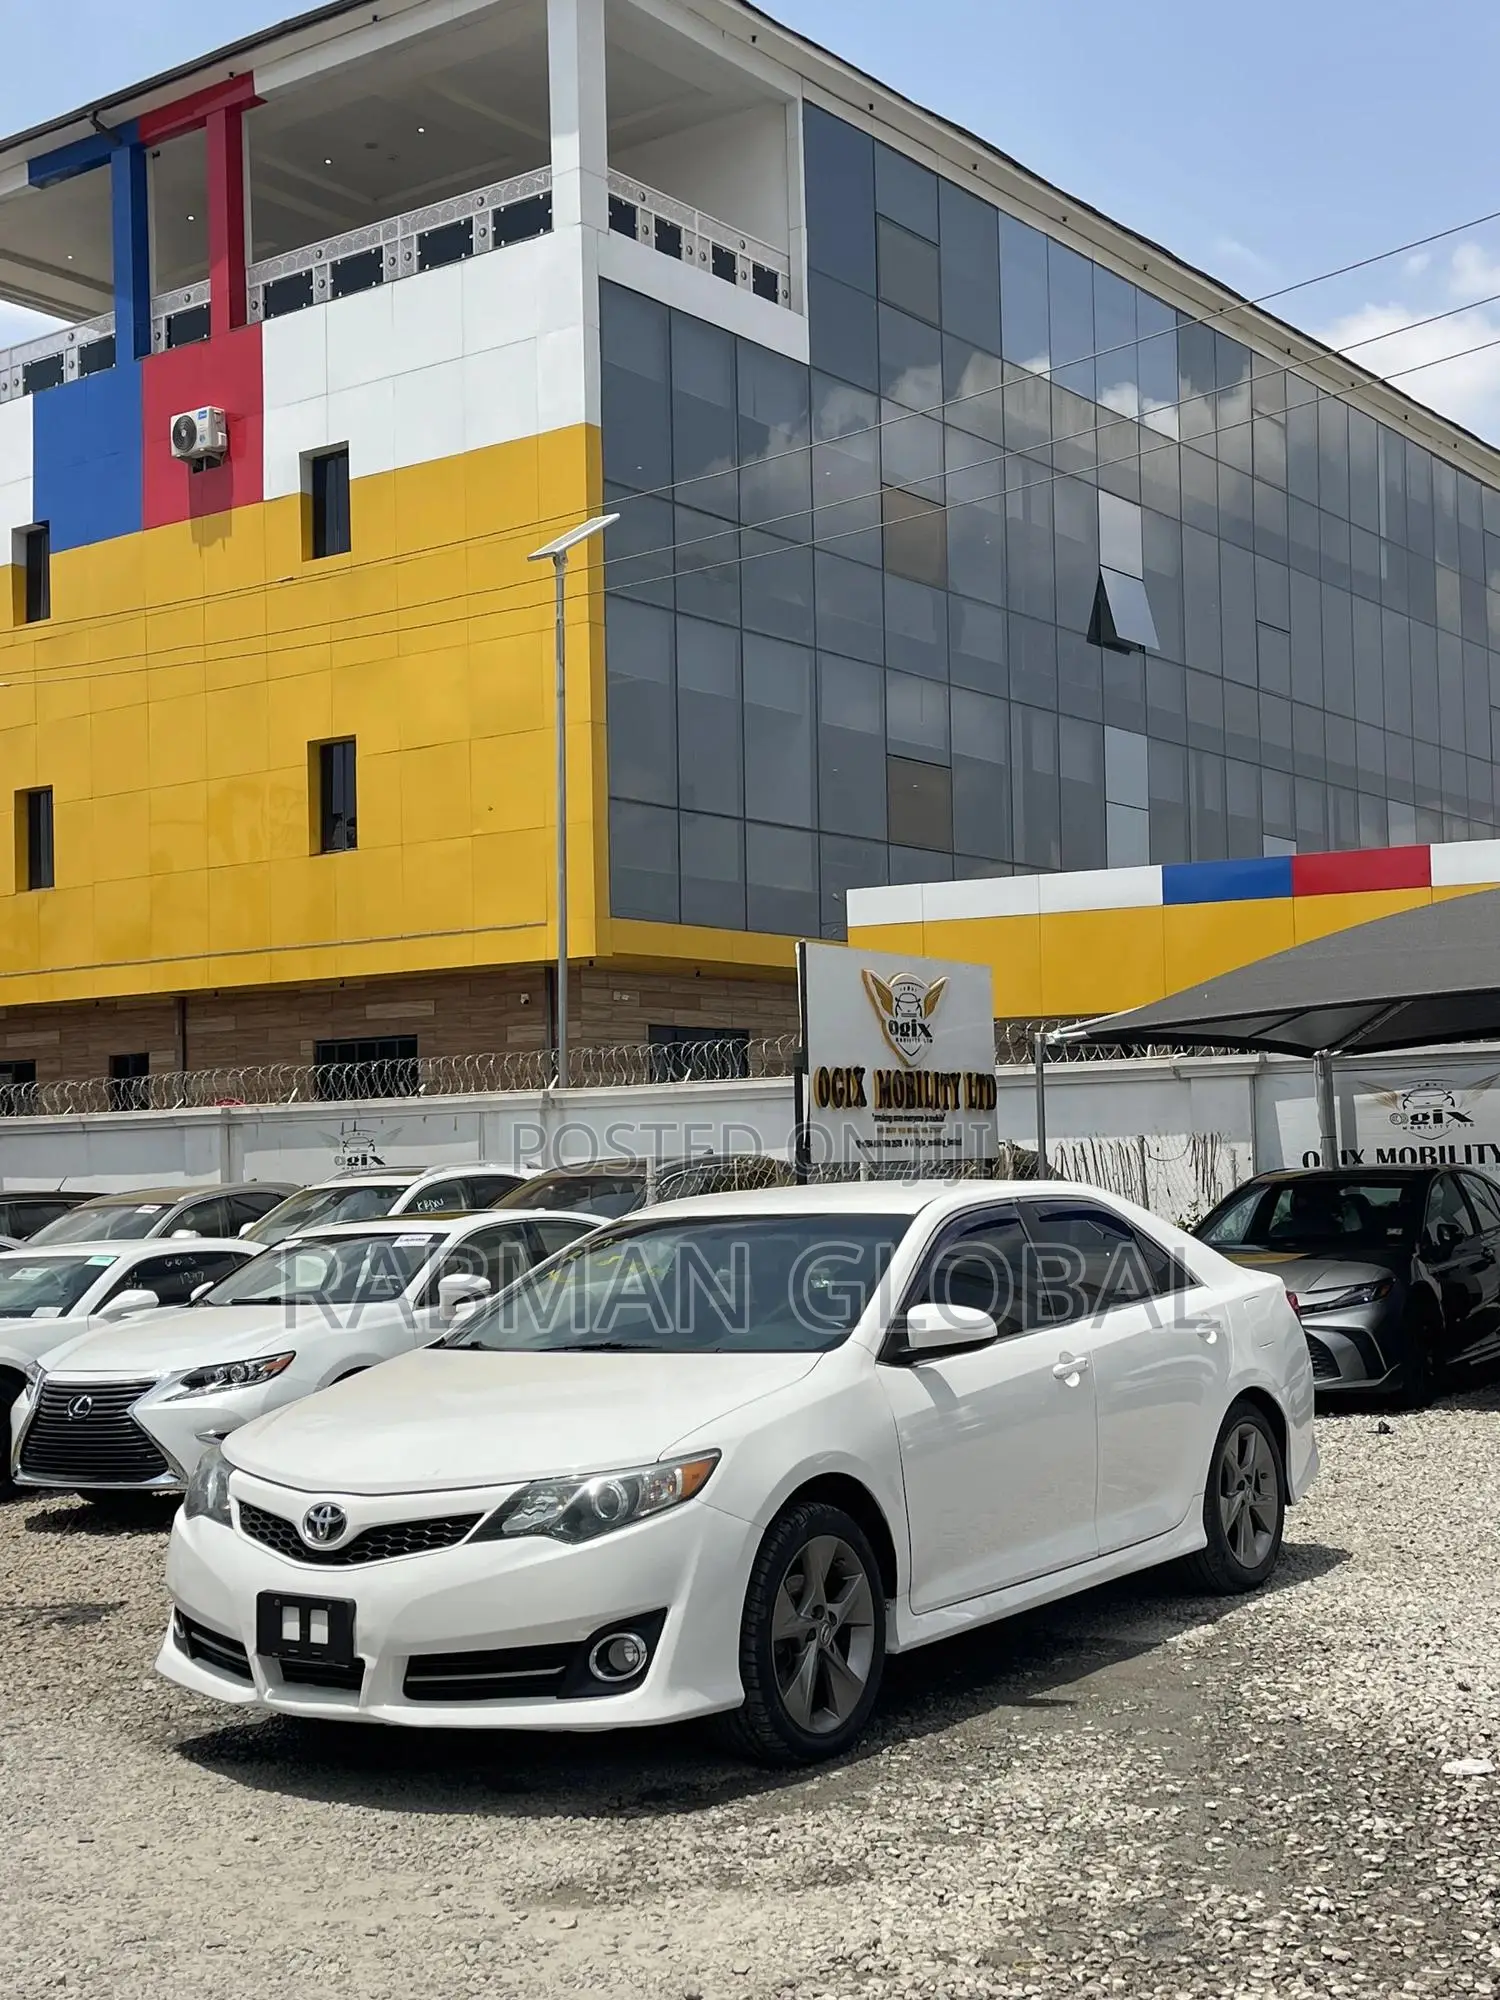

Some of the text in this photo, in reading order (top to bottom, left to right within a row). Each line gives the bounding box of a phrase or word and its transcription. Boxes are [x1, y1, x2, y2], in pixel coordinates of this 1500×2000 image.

[889, 1019, 932, 1037] Ogix
[813, 1066, 997, 1111] OGIX MOBILITY LTD
[1302, 1148, 1365, 1168] OIX
